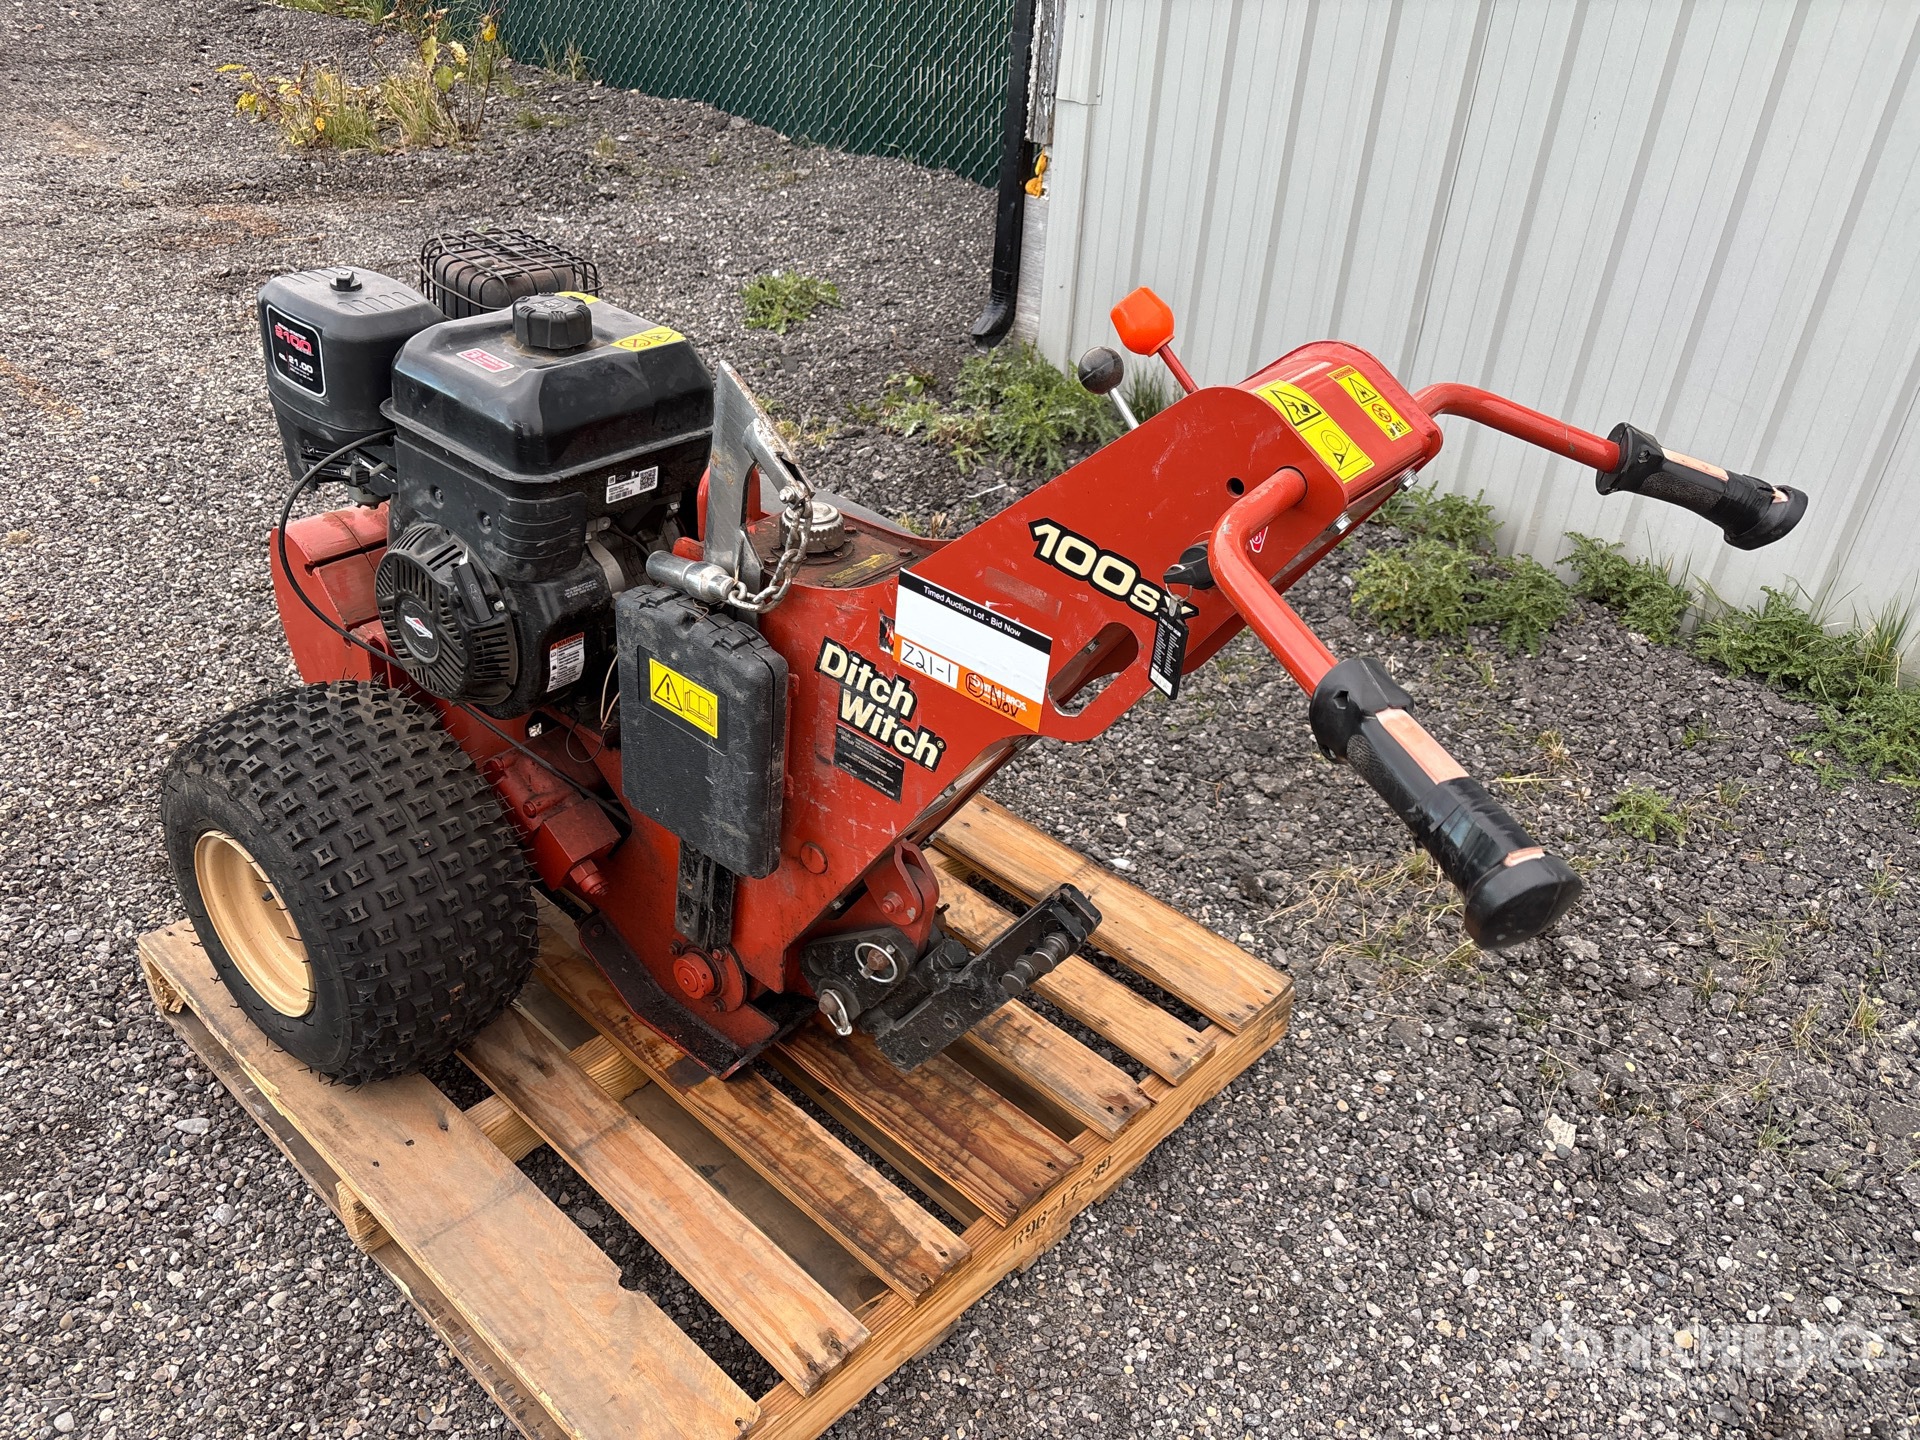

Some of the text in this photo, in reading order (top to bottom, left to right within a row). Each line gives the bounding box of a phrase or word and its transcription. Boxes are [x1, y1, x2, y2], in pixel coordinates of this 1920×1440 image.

[274, 324, 313, 354] 2100
[288, 354, 314, 374] 21.00
[923, 585, 945, 602] Timed
[945, 597, 972, 615] Auction
[972, 608, 985, 621] Lot
[990, 617, 1003, 629] Bid
[1003, 624, 1021, 638] Now
[819, 642, 914, 717] Ditch
